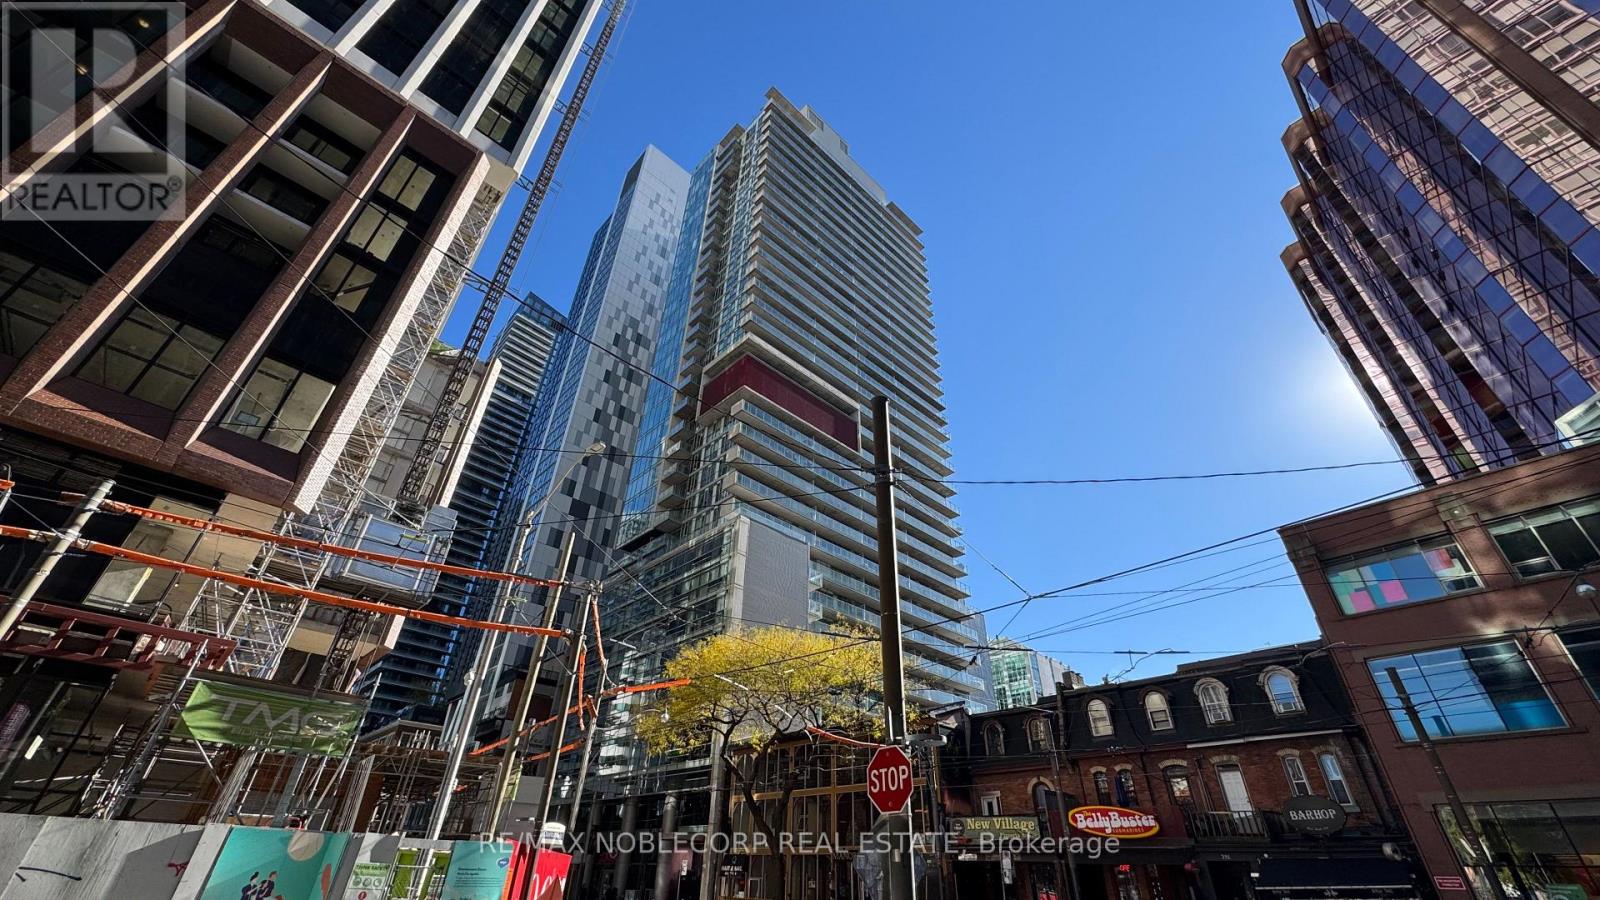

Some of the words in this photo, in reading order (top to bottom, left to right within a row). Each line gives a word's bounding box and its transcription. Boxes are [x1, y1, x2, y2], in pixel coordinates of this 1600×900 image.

[870, 765, 908, 793] STOP
[1289, 808, 1336, 821] BARHOP
[966, 818, 990, 830] New
[992, 817, 1034, 831] Village
